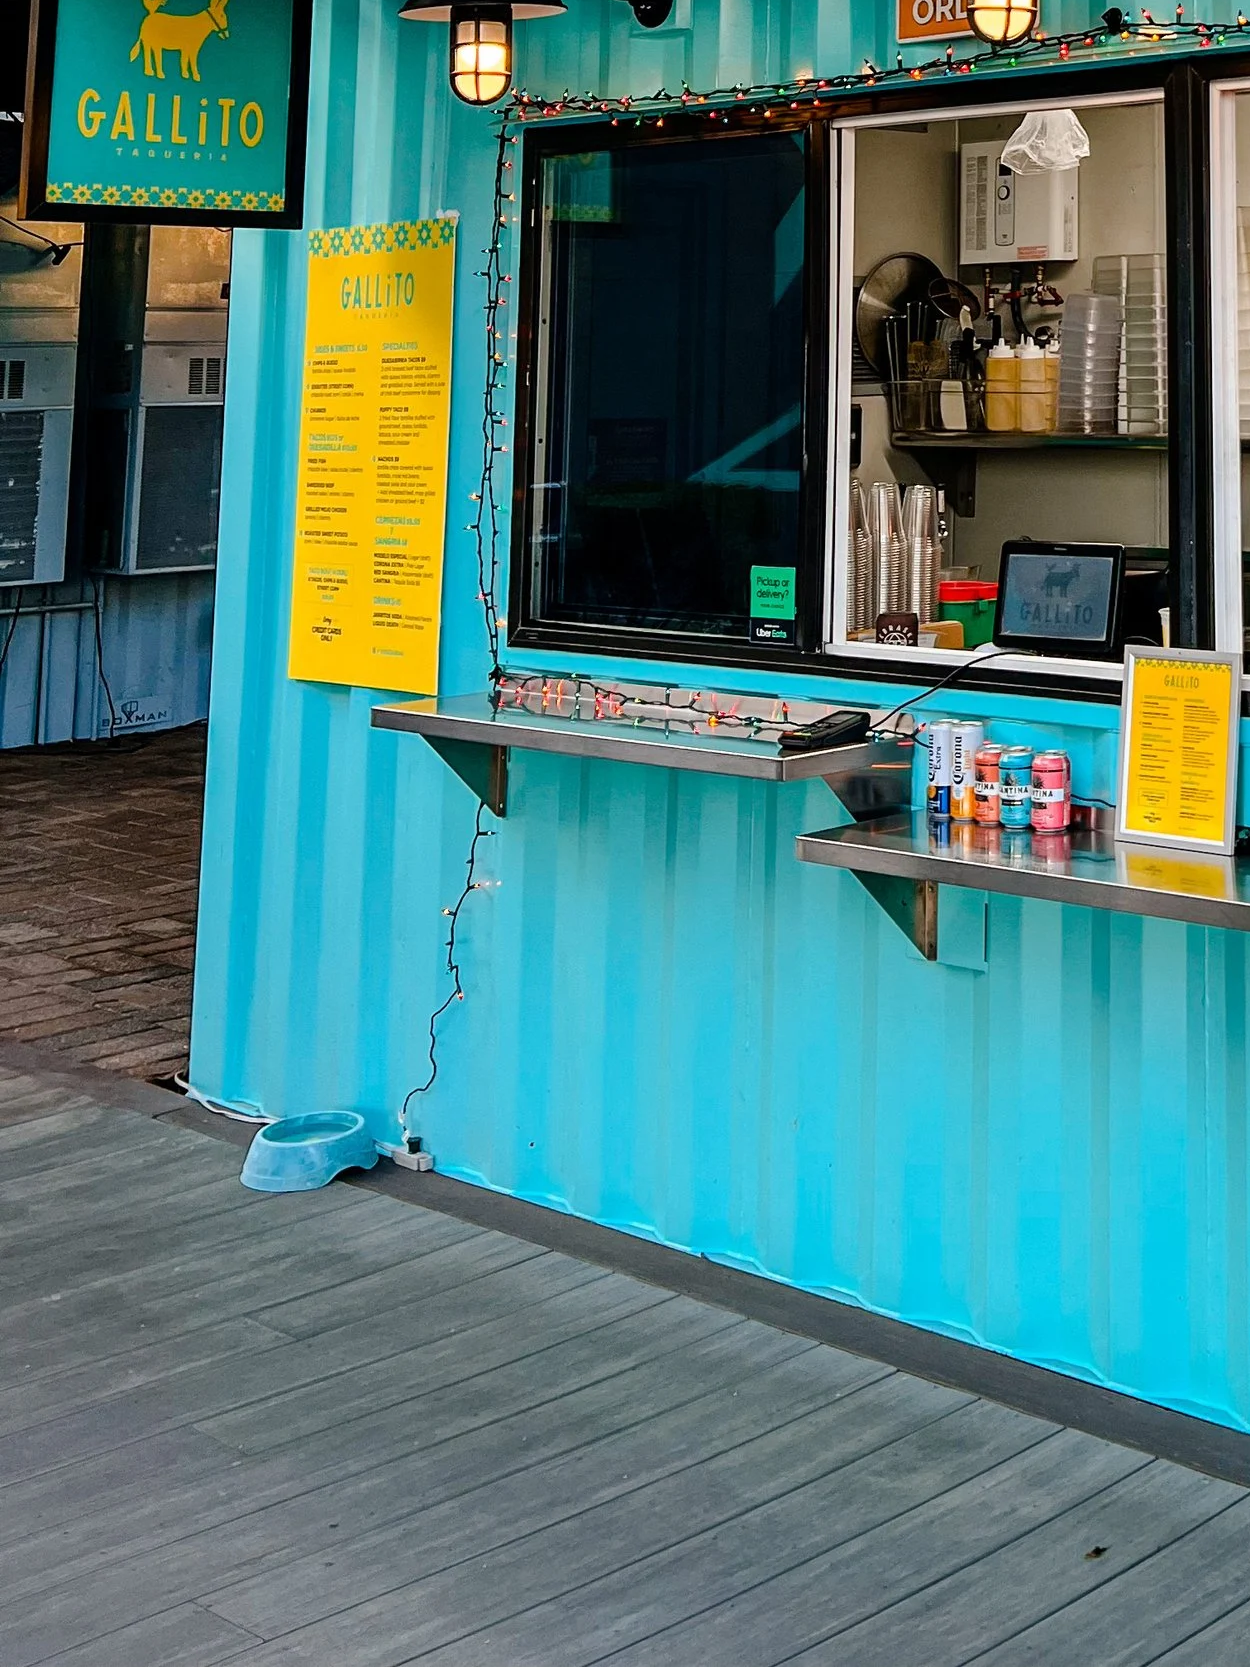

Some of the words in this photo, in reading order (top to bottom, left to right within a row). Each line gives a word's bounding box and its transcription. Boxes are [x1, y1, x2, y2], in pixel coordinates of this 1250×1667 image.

[116, 147, 228, 162] TAQUERIA
[757, 576, 780, 589] Pickup
[781, 579, 790, 587] or
[757, 589, 789, 601] delivery?
[756, 628, 771, 637] Uber
[772, 629, 787, 638] Eats
[934, 746, 942, 770] Extra
[953, 736, 965, 784] Corona
